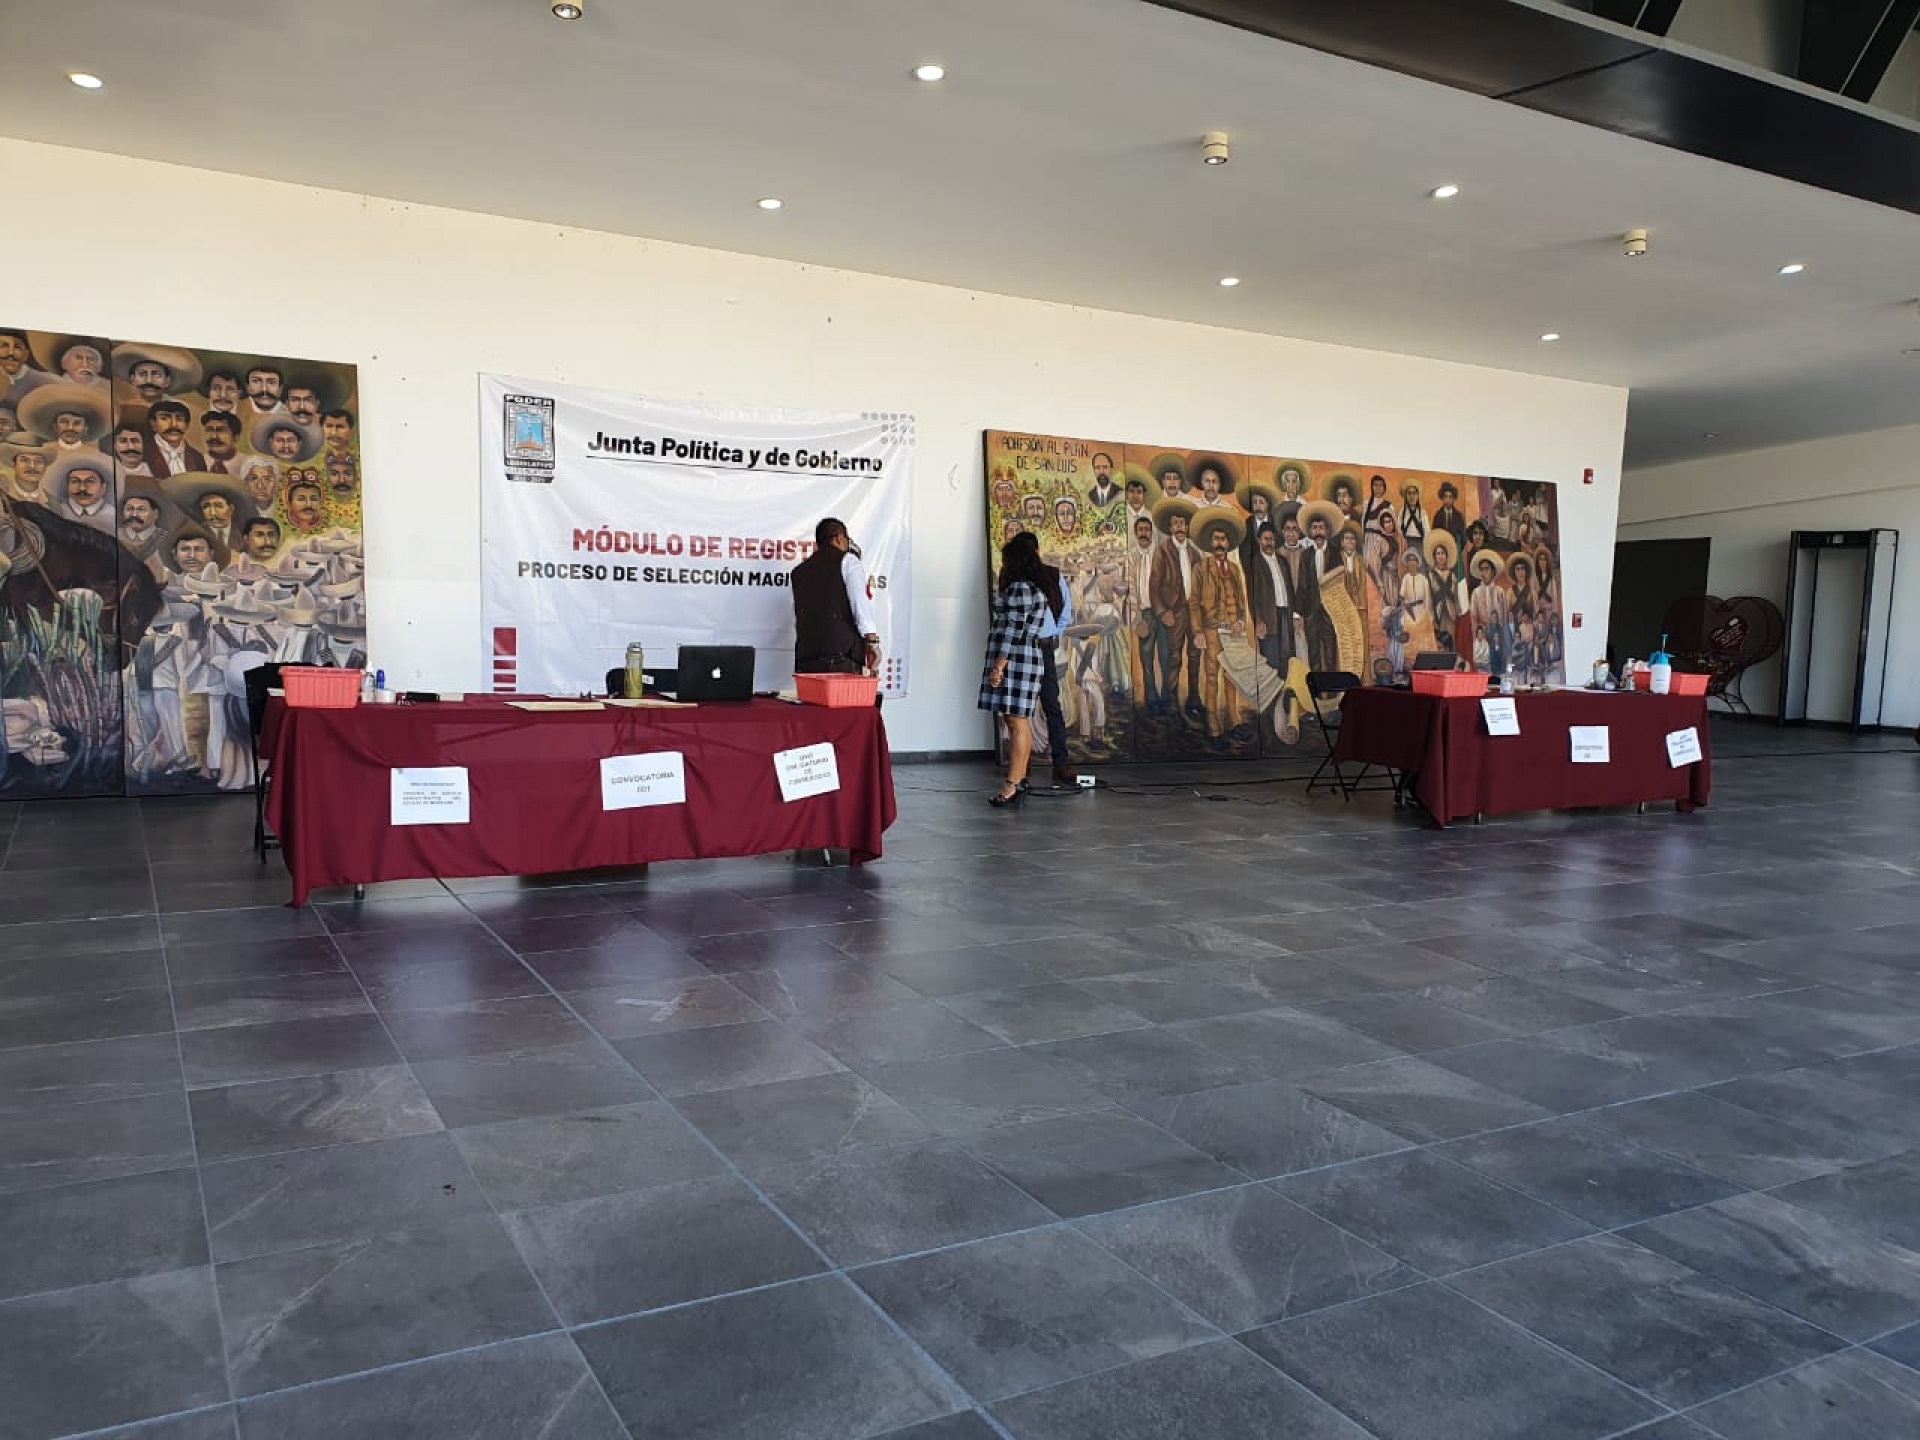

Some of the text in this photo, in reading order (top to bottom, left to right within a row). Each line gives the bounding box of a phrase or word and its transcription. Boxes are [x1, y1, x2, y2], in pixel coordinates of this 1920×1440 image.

[587, 431, 883, 472] Junta Política y de Gobierno
[1016, 455, 1030, 470] DE
[1057, 458, 1078, 473] LUIS
[573, 525, 817, 562] MÓDULO DE REGIST
[518, 561, 607, 582] PROCESO
[613, 566, 638, 582] DE
[643, 566, 743, 586] SELECCIÓN
[611, 771, 675, 784] CONVOCATORIA
